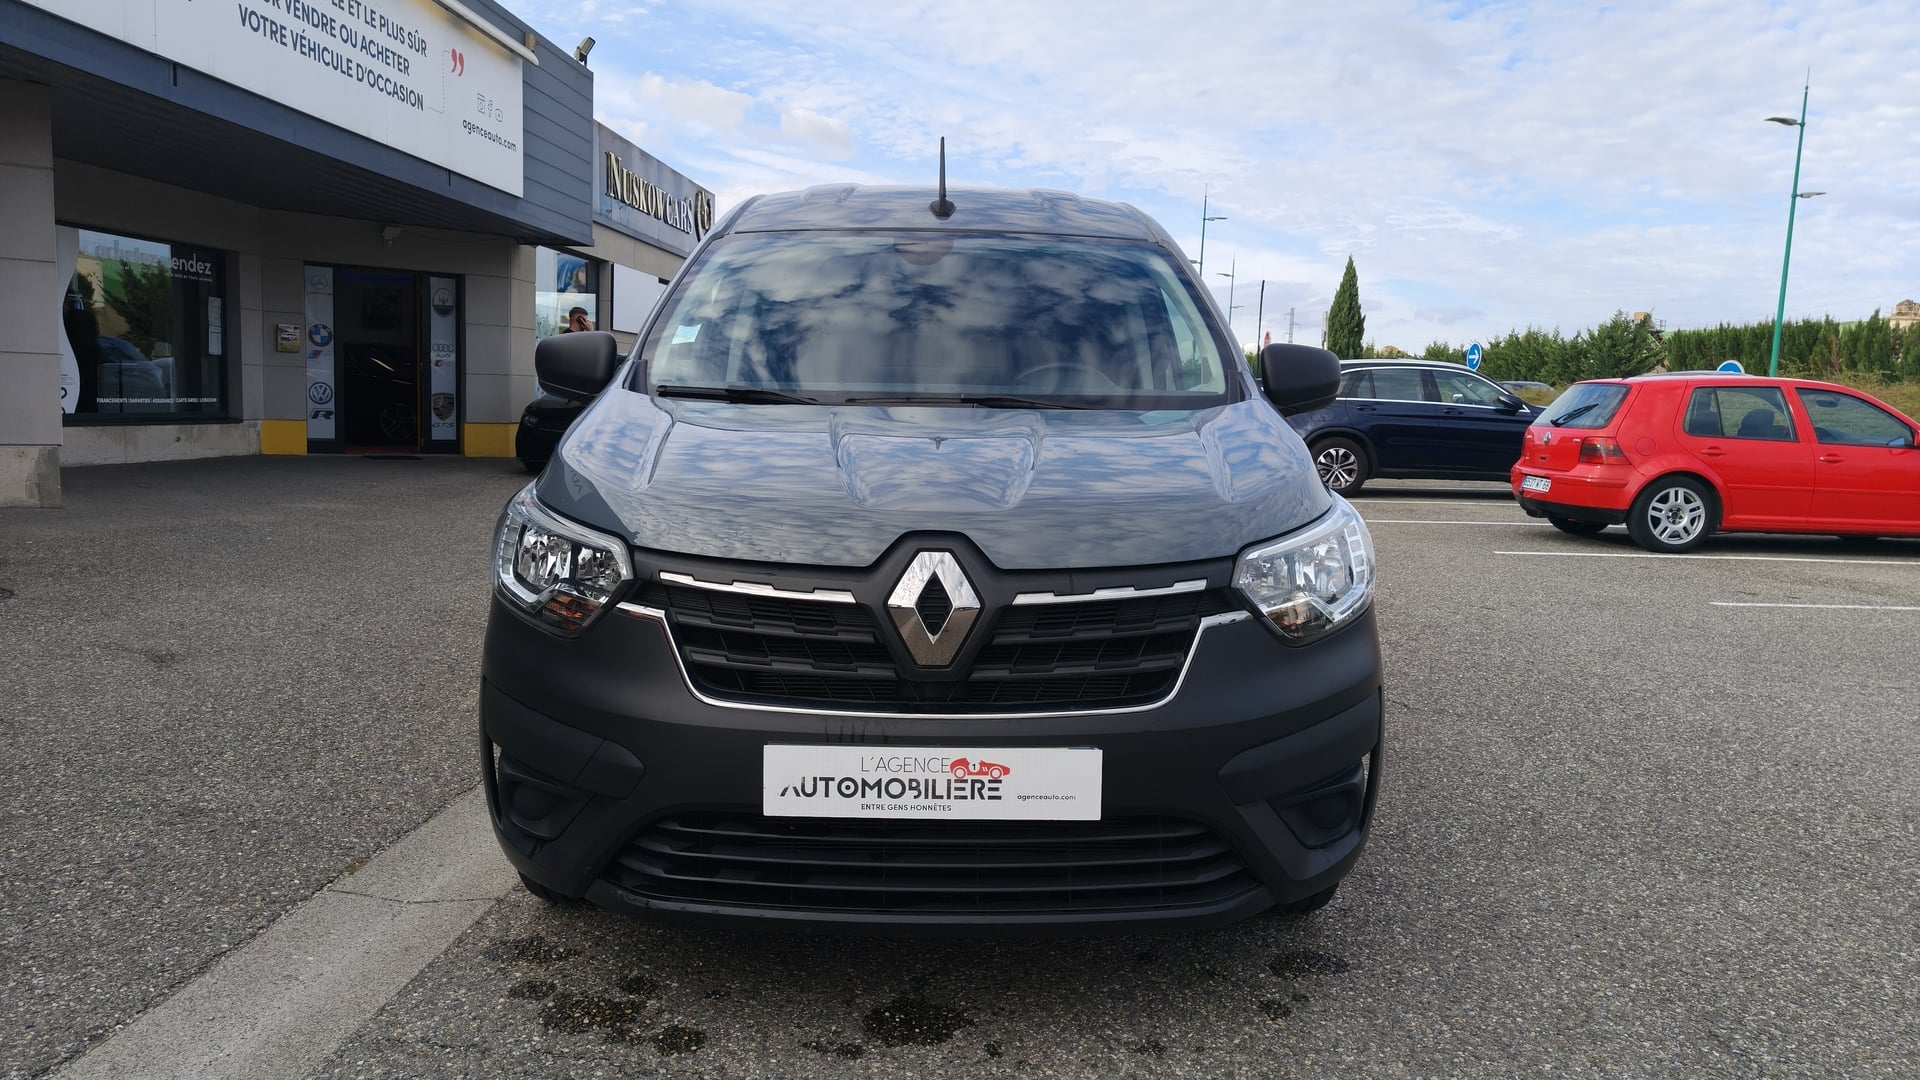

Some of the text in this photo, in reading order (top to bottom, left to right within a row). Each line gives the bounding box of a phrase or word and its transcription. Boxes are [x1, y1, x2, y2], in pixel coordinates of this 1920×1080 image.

[285, 0, 410, 77] VENDRE OU ACHETER
[348, 0, 362, 20] ET
[364, 5, 377, 29] LE
[379, 14, 405, 45] PLUS
[407, 29, 428, 57] SÛR
[238, 3, 425, 111] VOTRE VÉHICULE D'OCCASION
[462, 119, 517, 152] agenceauto.com
[171, 252, 213, 275] endez
[861, 802, 952, 812] ENTRE GENS HONNÊTES
[1017, 793, 1076, 801] agenceauto.com
